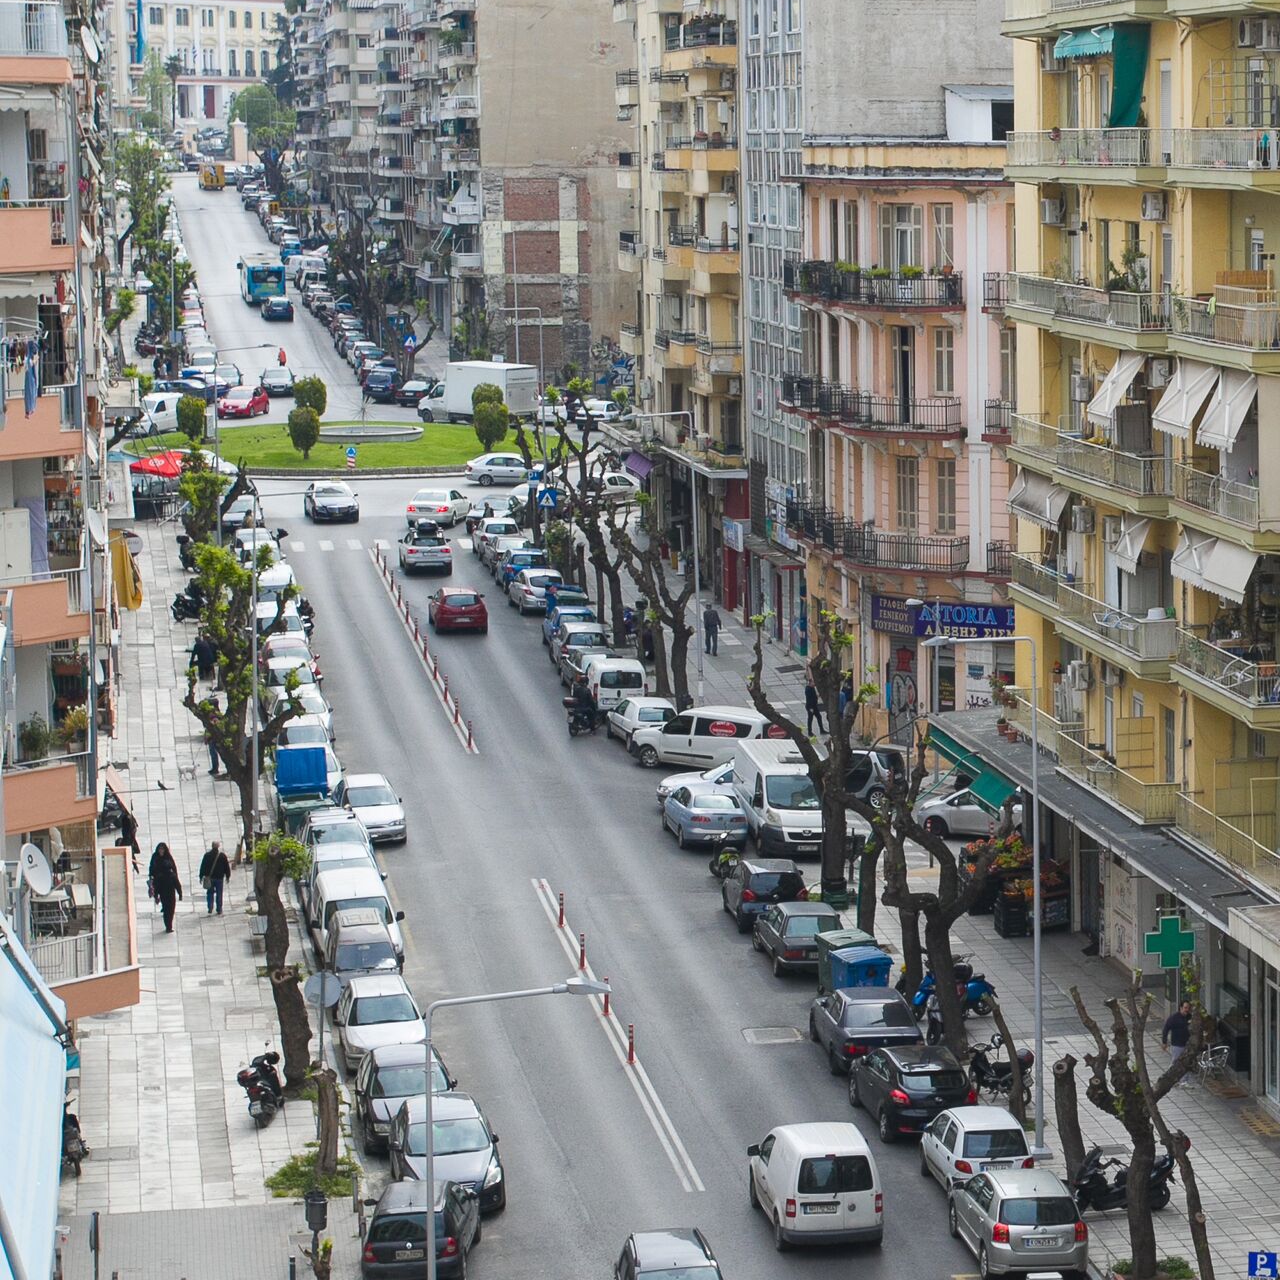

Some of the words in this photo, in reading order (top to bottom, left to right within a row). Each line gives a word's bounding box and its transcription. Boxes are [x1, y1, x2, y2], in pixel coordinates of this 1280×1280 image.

[879, 609, 909, 622] ΓΕΝΙΚΟΥ
[919, 605, 998, 625] ASTORIA
[874, 620, 914, 634] ΤΟΥΡΙΣΜΟΥ
[1257, 1254, 1268, 1269] P
